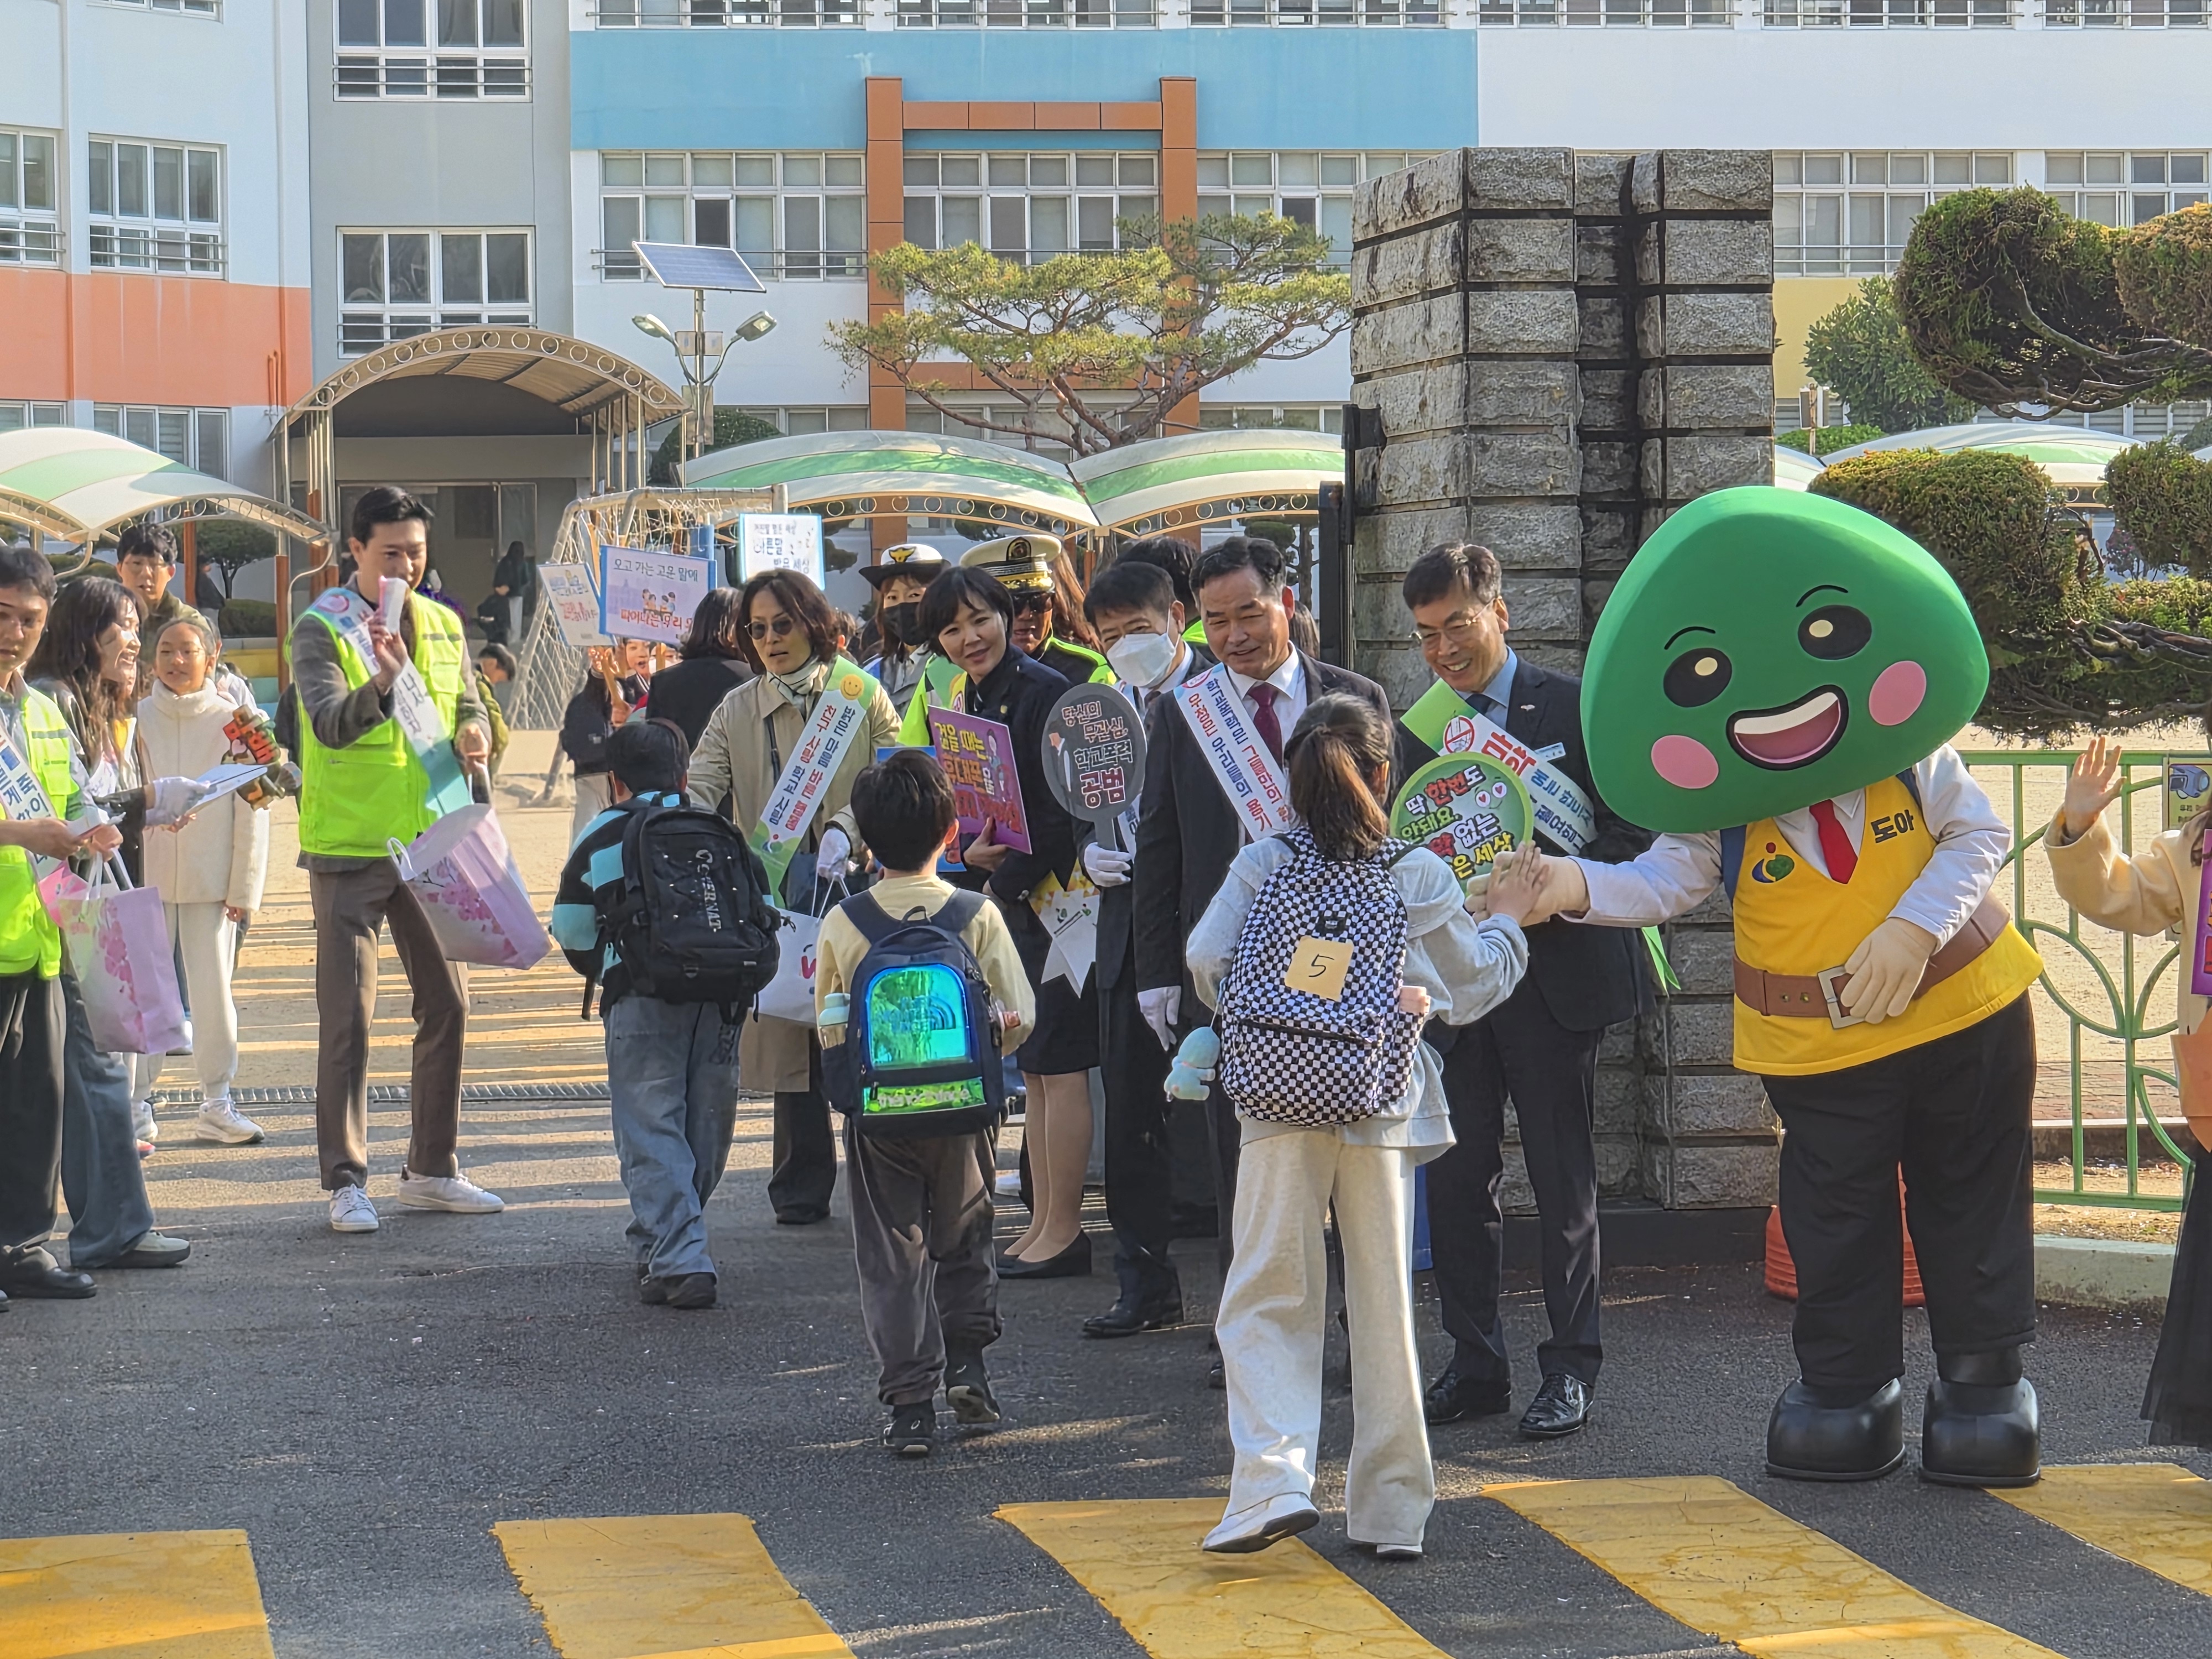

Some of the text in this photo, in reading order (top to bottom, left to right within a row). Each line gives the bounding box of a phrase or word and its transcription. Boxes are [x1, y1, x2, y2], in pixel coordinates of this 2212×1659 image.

[613, 559, 698, 582] 오고 가는 고운 말에
[1062, 701, 1102, 727] 당신의
[818, 738, 839, 768] 마음
[934, 722, 988, 761] 걸을 때는
[1073, 739, 1133, 771] 학교폭력
[769, 705, 837, 826] 친구 사랑 학교 사랑
[1188, 693, 1218, 737] 우정은
[1212, 737, 1253, 798] 우리들의
[1246, 798, 1272, 832] 용기
[802, 769, 823, 800] 바른
[1080, 766, 1125, 808] 공범
[1405, 795, 1426, 815] 딱
[1455, 814, 1498, 847] 없는
[1870, 809, 1914, 843] 도아
[1474, 832, 1513, 864] 세상
[1308, 954, 1335, 977] 5
